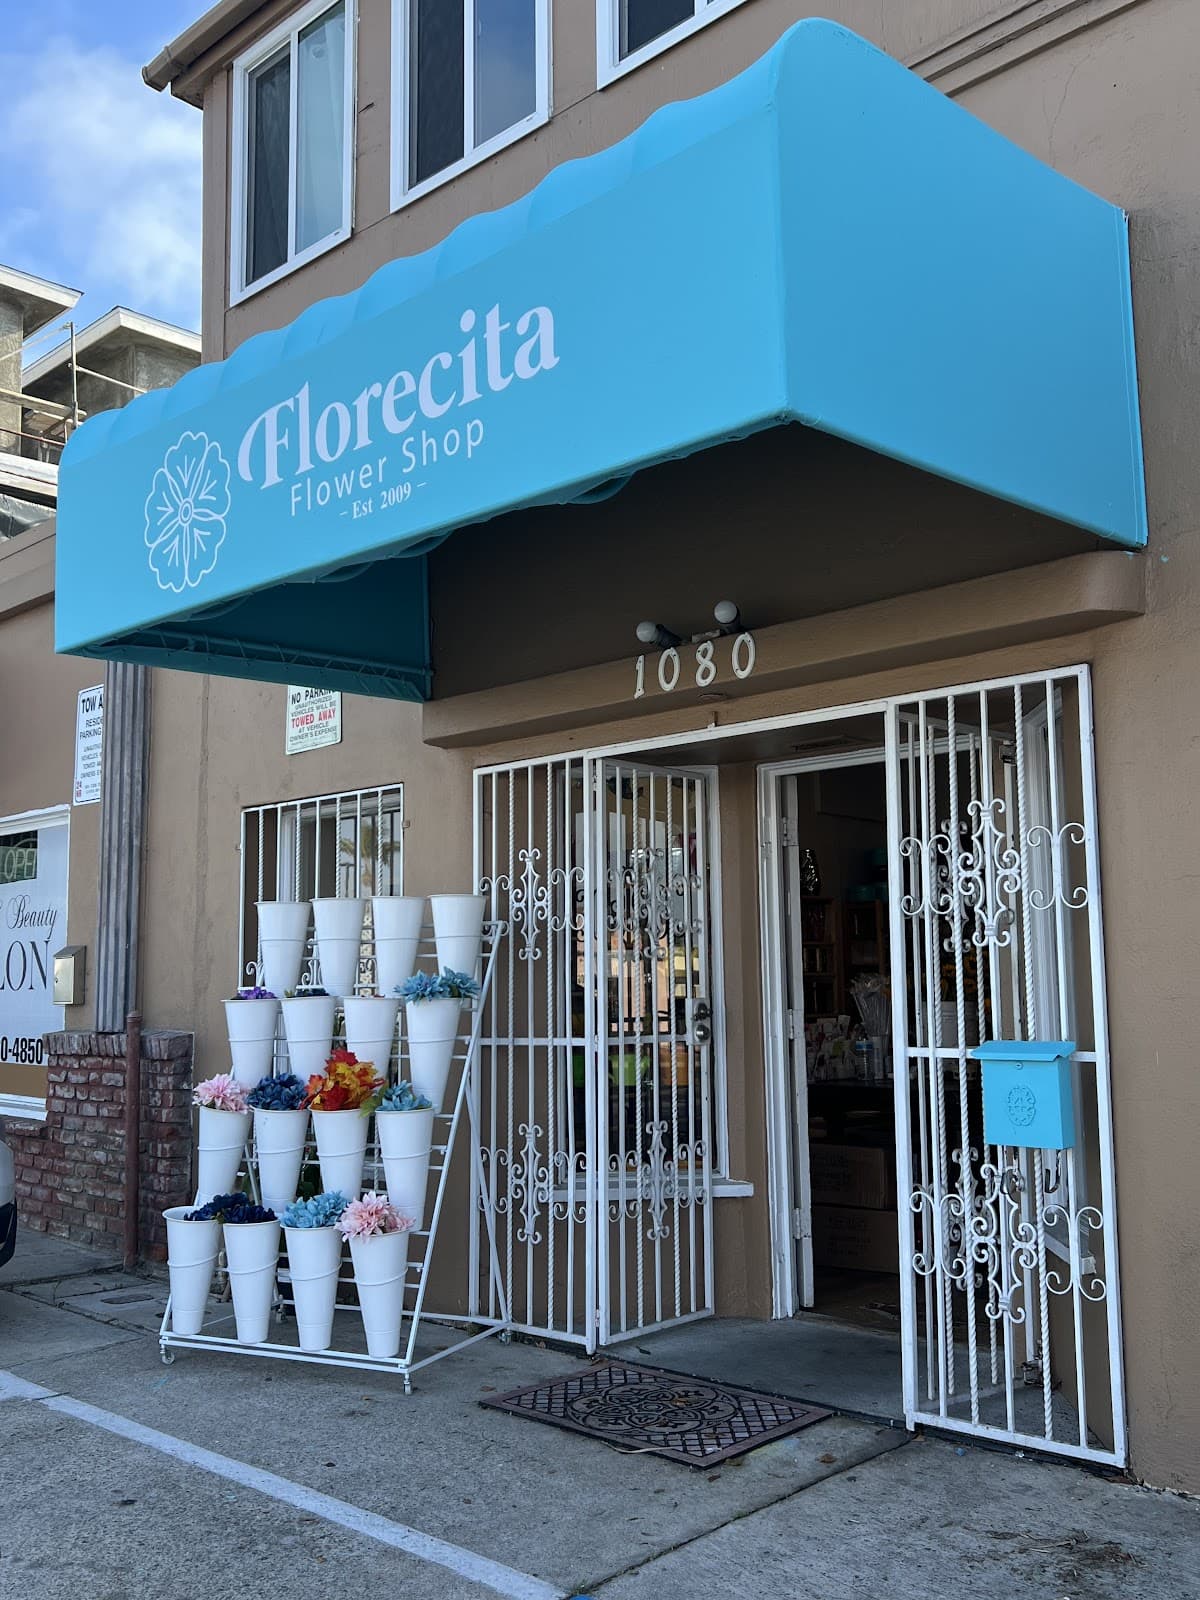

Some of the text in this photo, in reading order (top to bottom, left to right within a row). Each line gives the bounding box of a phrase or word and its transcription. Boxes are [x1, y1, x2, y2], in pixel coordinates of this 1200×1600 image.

[238, 303, 560, 489] Florecita
[290, 419, 484, 517] Flower Shop
[352, 482, 412, 520] Est 2009
[634, 632, 755, 699] 1080
[81, 695, 96, 713] TOW
[291, 692, 301, 705] NO
[291, 707, 336, 728] TOWED AWAY
[6, 894, 58, 940] Beauty
